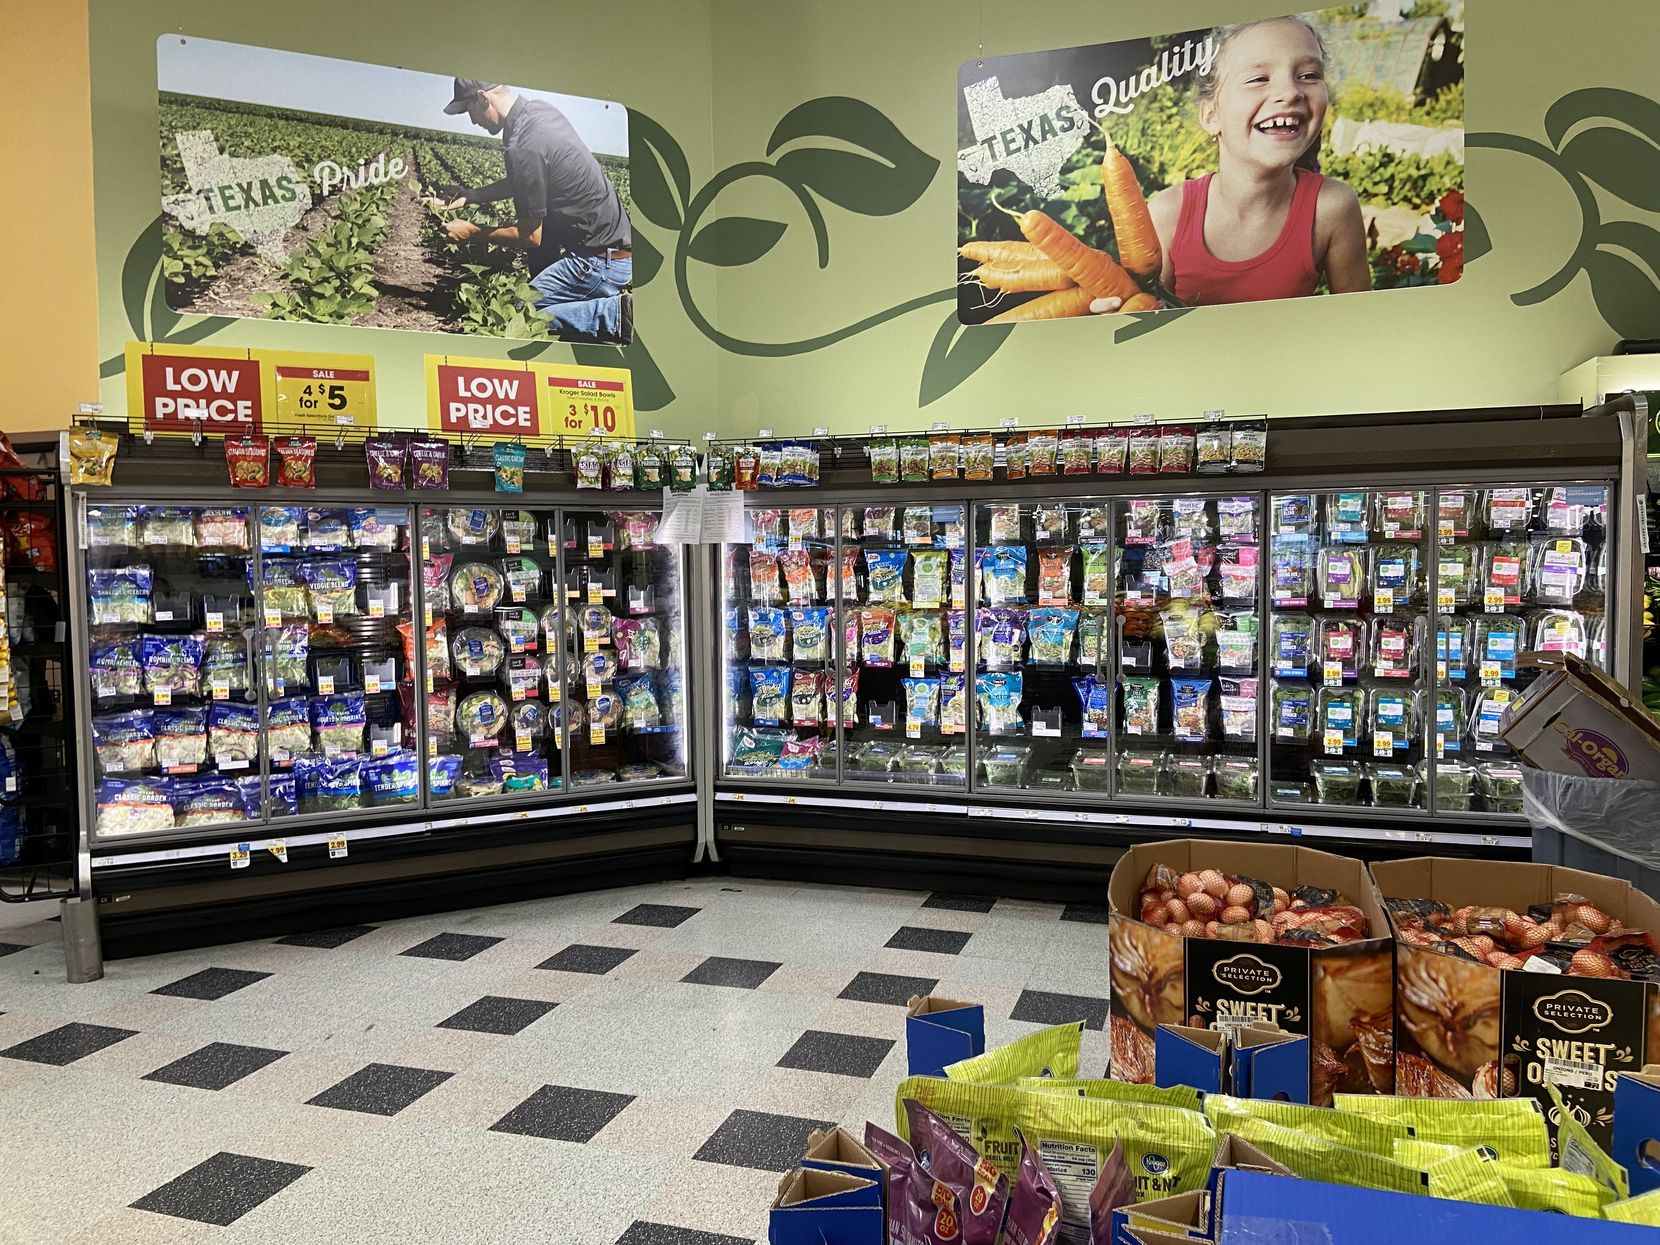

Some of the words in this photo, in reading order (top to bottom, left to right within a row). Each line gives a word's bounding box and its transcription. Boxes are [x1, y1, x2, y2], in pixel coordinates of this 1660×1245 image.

[980, 104, 1077, 163] TEXAS
[1091, 36, 1221, 118] Quality
[201, 175, 297, 215] TEXAS
[313, 154, 409, 196] Pride
[165, 367, 240, 393] LOW
[312, 370, 335, 379] SALE
[303, 384, 313, 396] 4
[458, 376, 519, 400] LOW
[155, 397, 252, 422] PRICE
[299, 398, 318, 410] for
[569, 404, 577, 416] 3
[450, 402, 531, 427] PRICE
[564, 416, 582, 429] for
[374, 784, 395, 792] TENDER
[184, 802, 208, 810] CLASSIC
[1221, 973, 1272, 982] SELECTION
[1224, 967, 1269, 977] PRIVATE
[1216, 999, 1286, 1023] SWEET
[1544, 1010, 1602, 1020] SELECTION
[1546, 1003, 1599, 1014] PRIVATE
[1536, 1037, 1617, 1066] SWEET
[984, 1140, 1020, 1155] FRUIT
[1042, 1142, 1073, 1151] Nutrition
[1145, 1155, 1166, 1171] Kroger
[1152, 1178, 1161, 1191] &
[940, 1213, 954, 1227] 20
